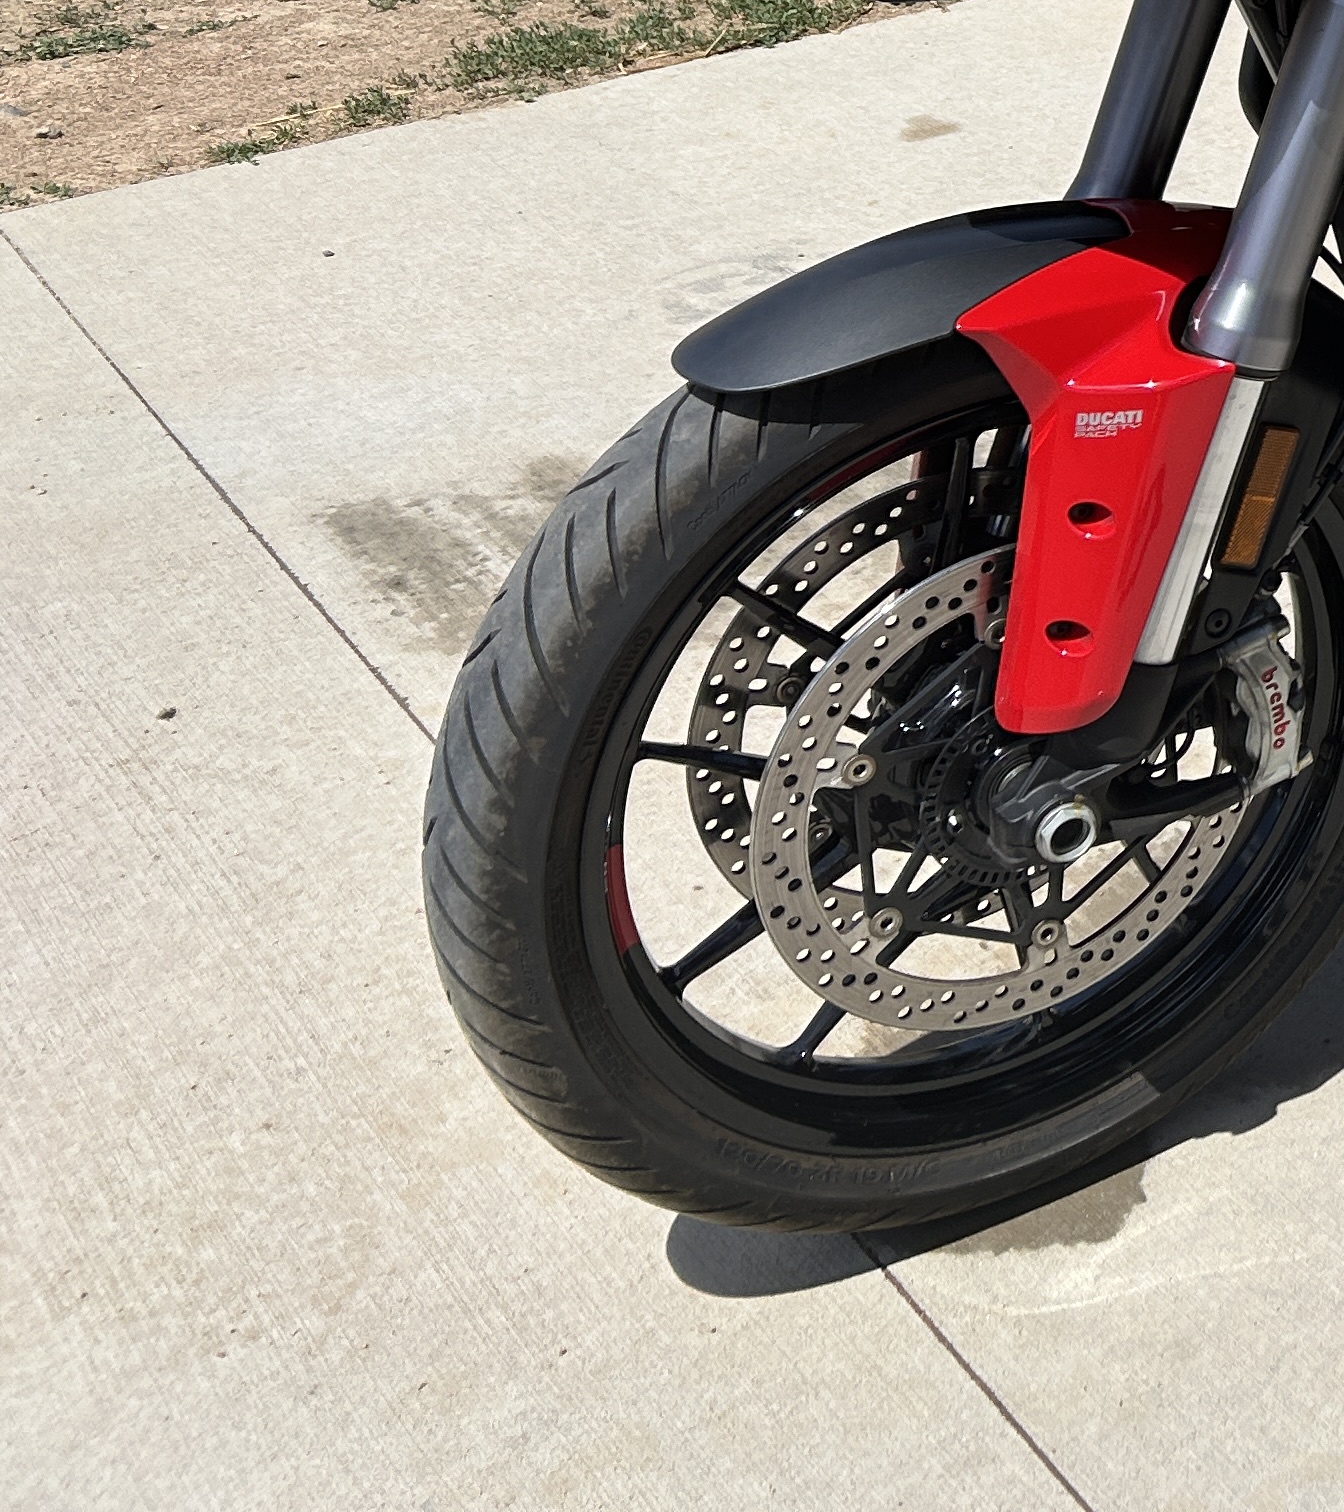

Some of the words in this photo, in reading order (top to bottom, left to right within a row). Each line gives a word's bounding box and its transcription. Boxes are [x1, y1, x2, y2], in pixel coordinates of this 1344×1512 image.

[1075, 410, 1143, 425] DUCATI
[1261, 666, 1291, 750] brembo
[854, 1165, 883, 1184] 19
